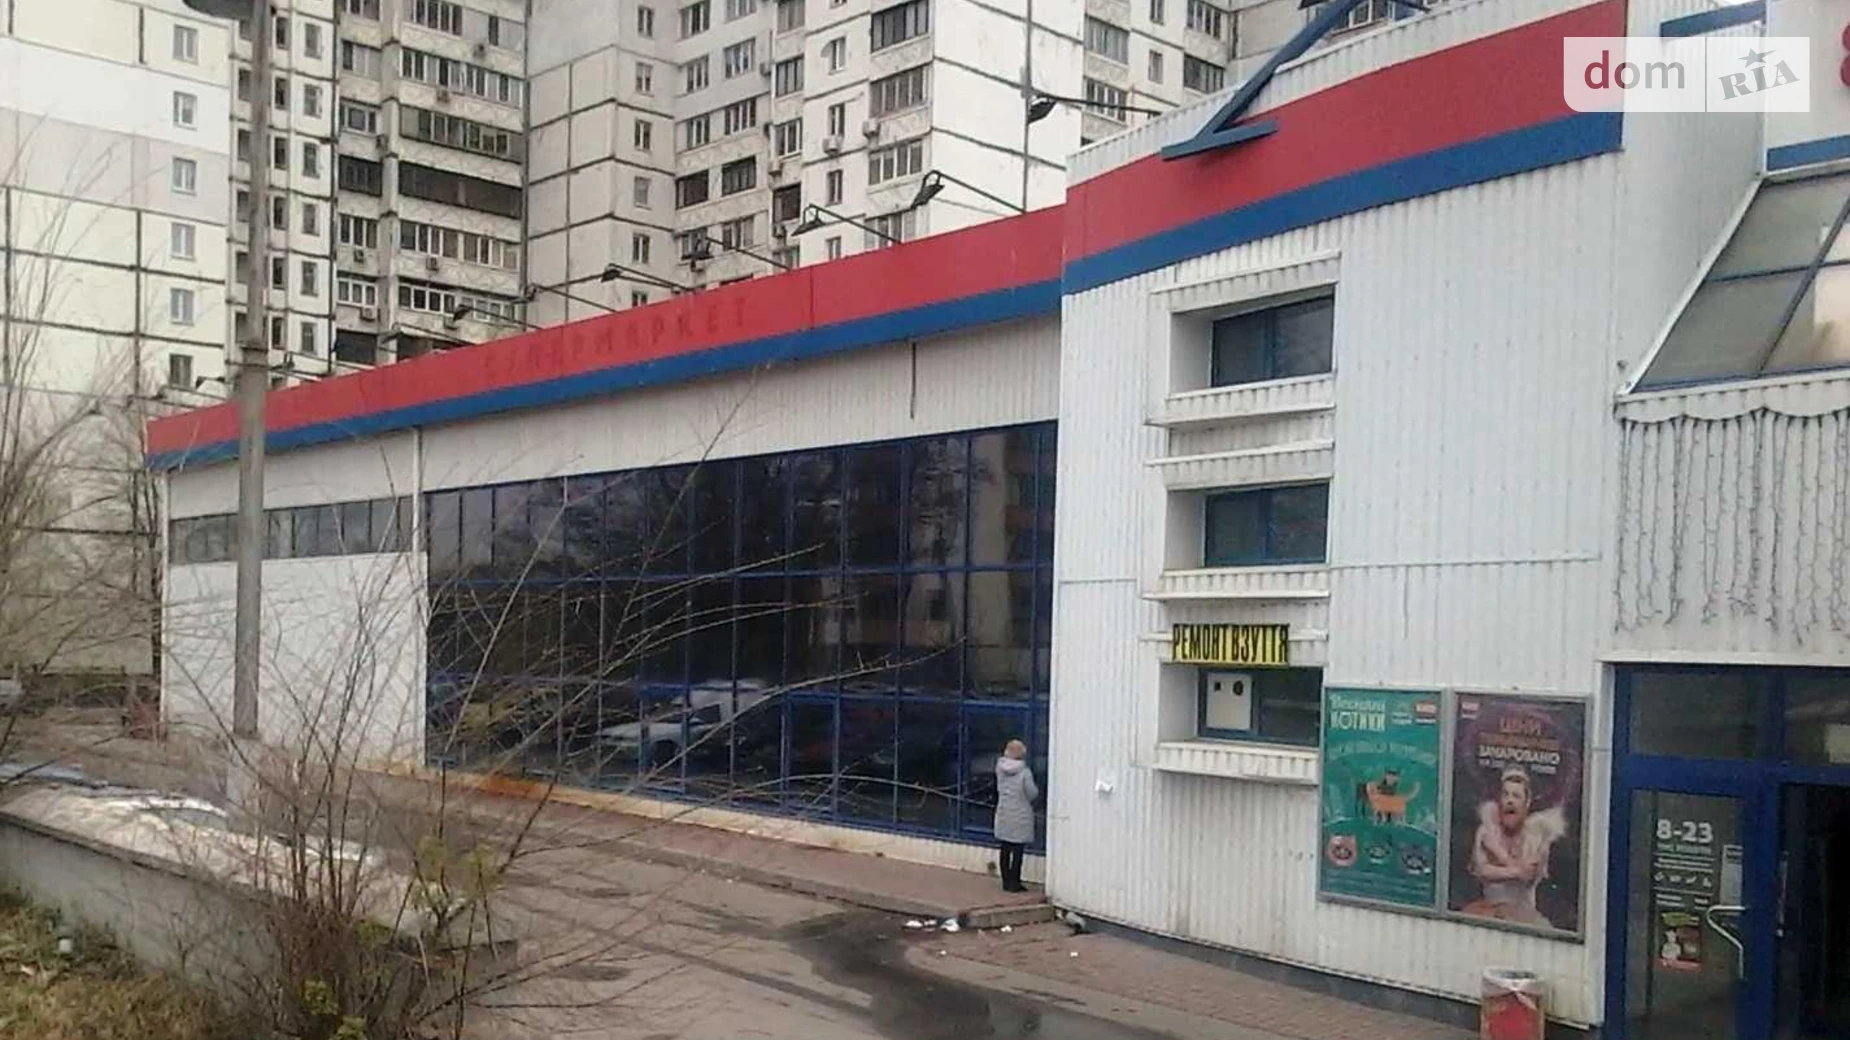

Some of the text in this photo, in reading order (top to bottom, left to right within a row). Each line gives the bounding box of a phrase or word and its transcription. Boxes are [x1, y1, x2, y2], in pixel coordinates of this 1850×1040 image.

[483, 297, 747, 379] СУПЕРМАРКЕТ
[1173, 623, 1288, 662] РЕМОНТ ВЗУТТЯ
[1656, 818, 1714, 844] 8-23
